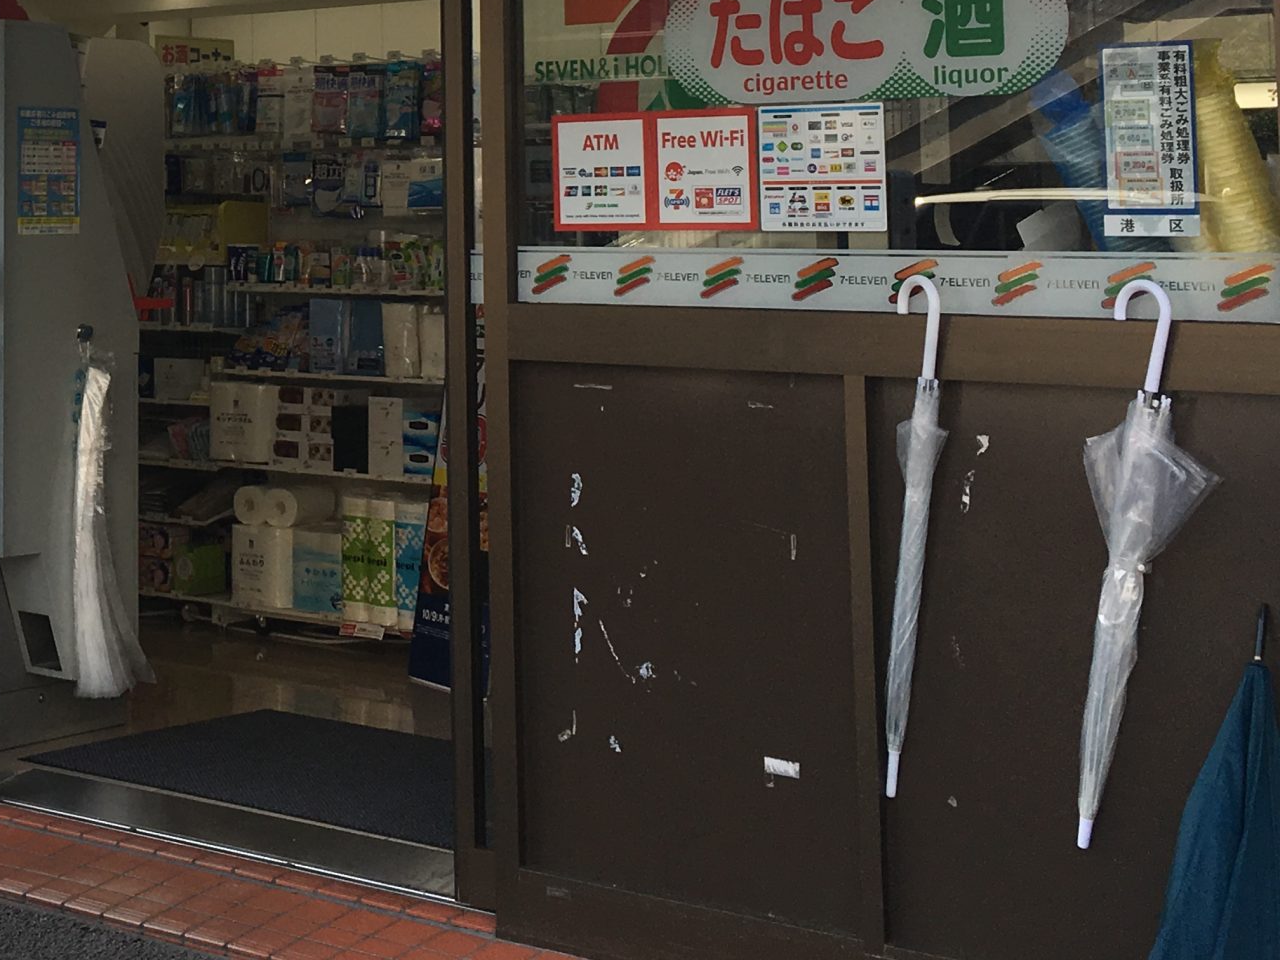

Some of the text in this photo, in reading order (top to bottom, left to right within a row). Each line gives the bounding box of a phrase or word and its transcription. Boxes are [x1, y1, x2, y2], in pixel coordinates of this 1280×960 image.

[160, 43, 232, 64] お酒コーナー
[743, 69, 850, 94] cigarette
[932, 62, 1009, 89] liquor
[1172, 49, 1191, 165] 有料粗大ごみ処理券
[582, 133, 620, 152] ATM
[661, 129, 745, 149] Free Wi-Fi
[716, 188, 740, 196] FLET'S
[1169, 167, 1184, 206] 取扱所
